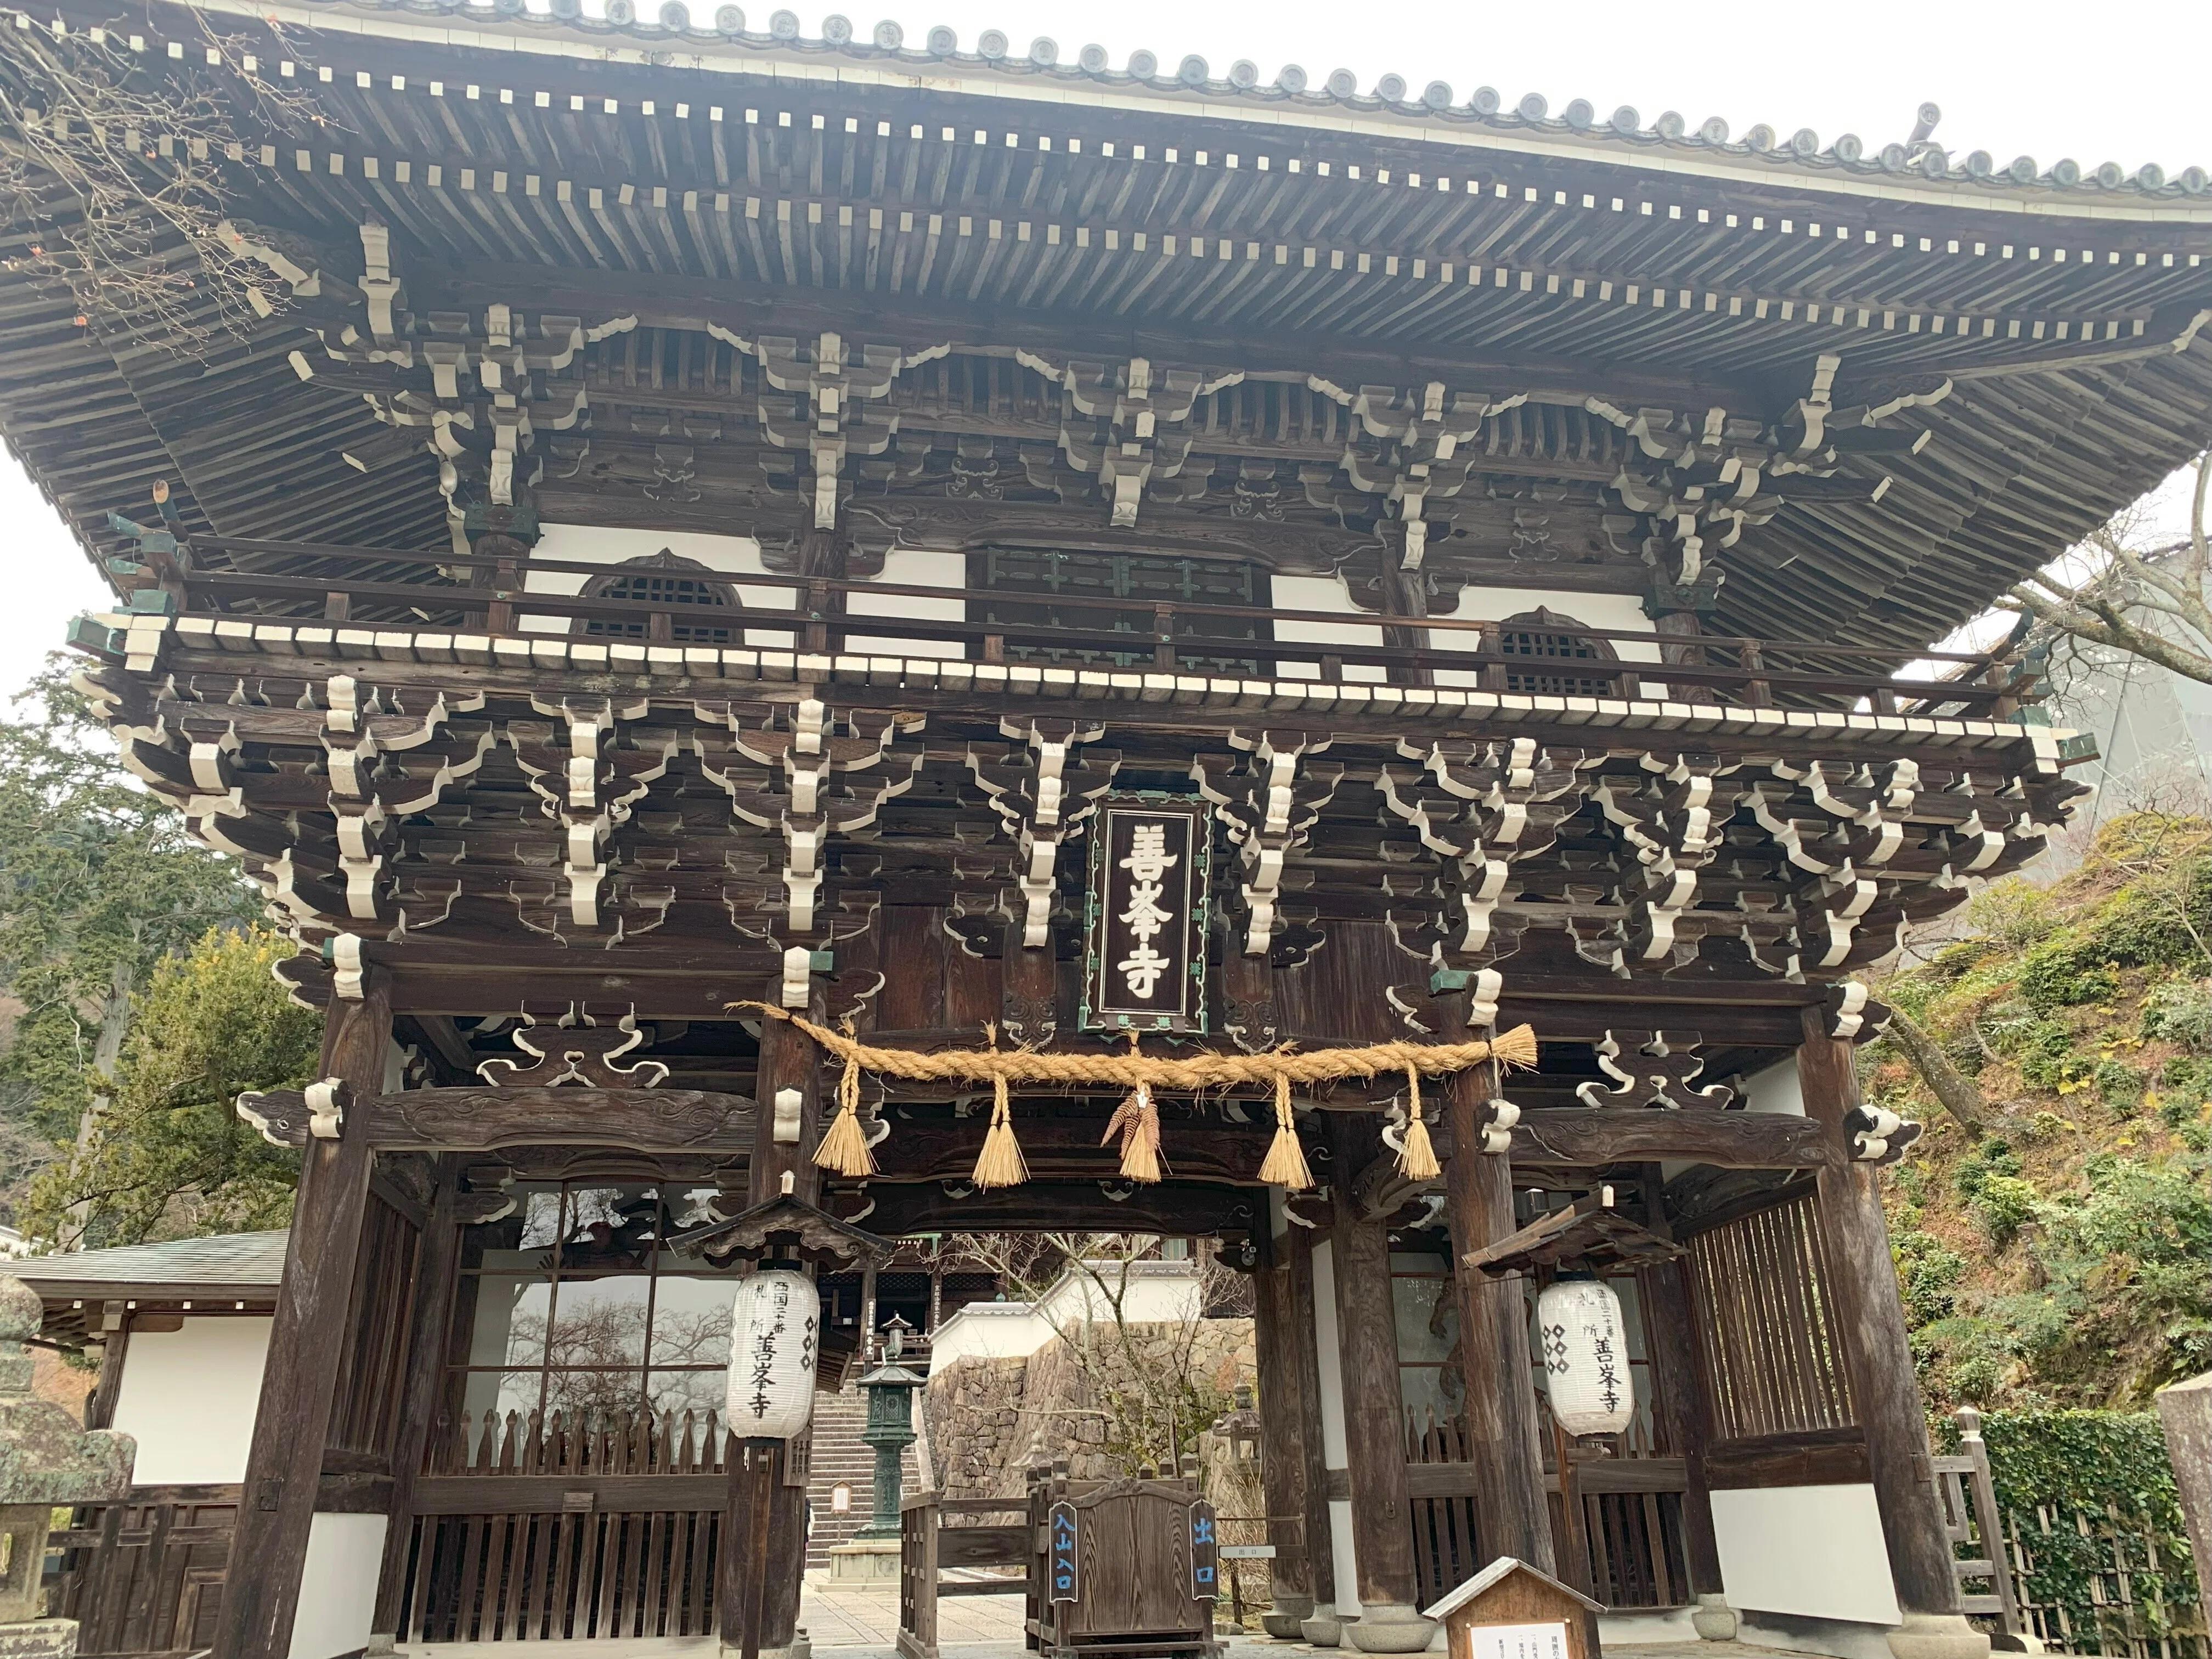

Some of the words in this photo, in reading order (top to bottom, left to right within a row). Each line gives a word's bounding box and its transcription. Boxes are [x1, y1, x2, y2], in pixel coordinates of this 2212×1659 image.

[1118, 823, 1178, 999] 善峯寺
[773, 1282, 788, 1334] 西国二十番
[747, 1331, 777, 1419] 善峯寺
[1593, 1336, 1622, 1414] 善峯寺
[1054, 1514, 1075, 1589] 入山入口
[1194, 1518, 1214, 1583] 出口
